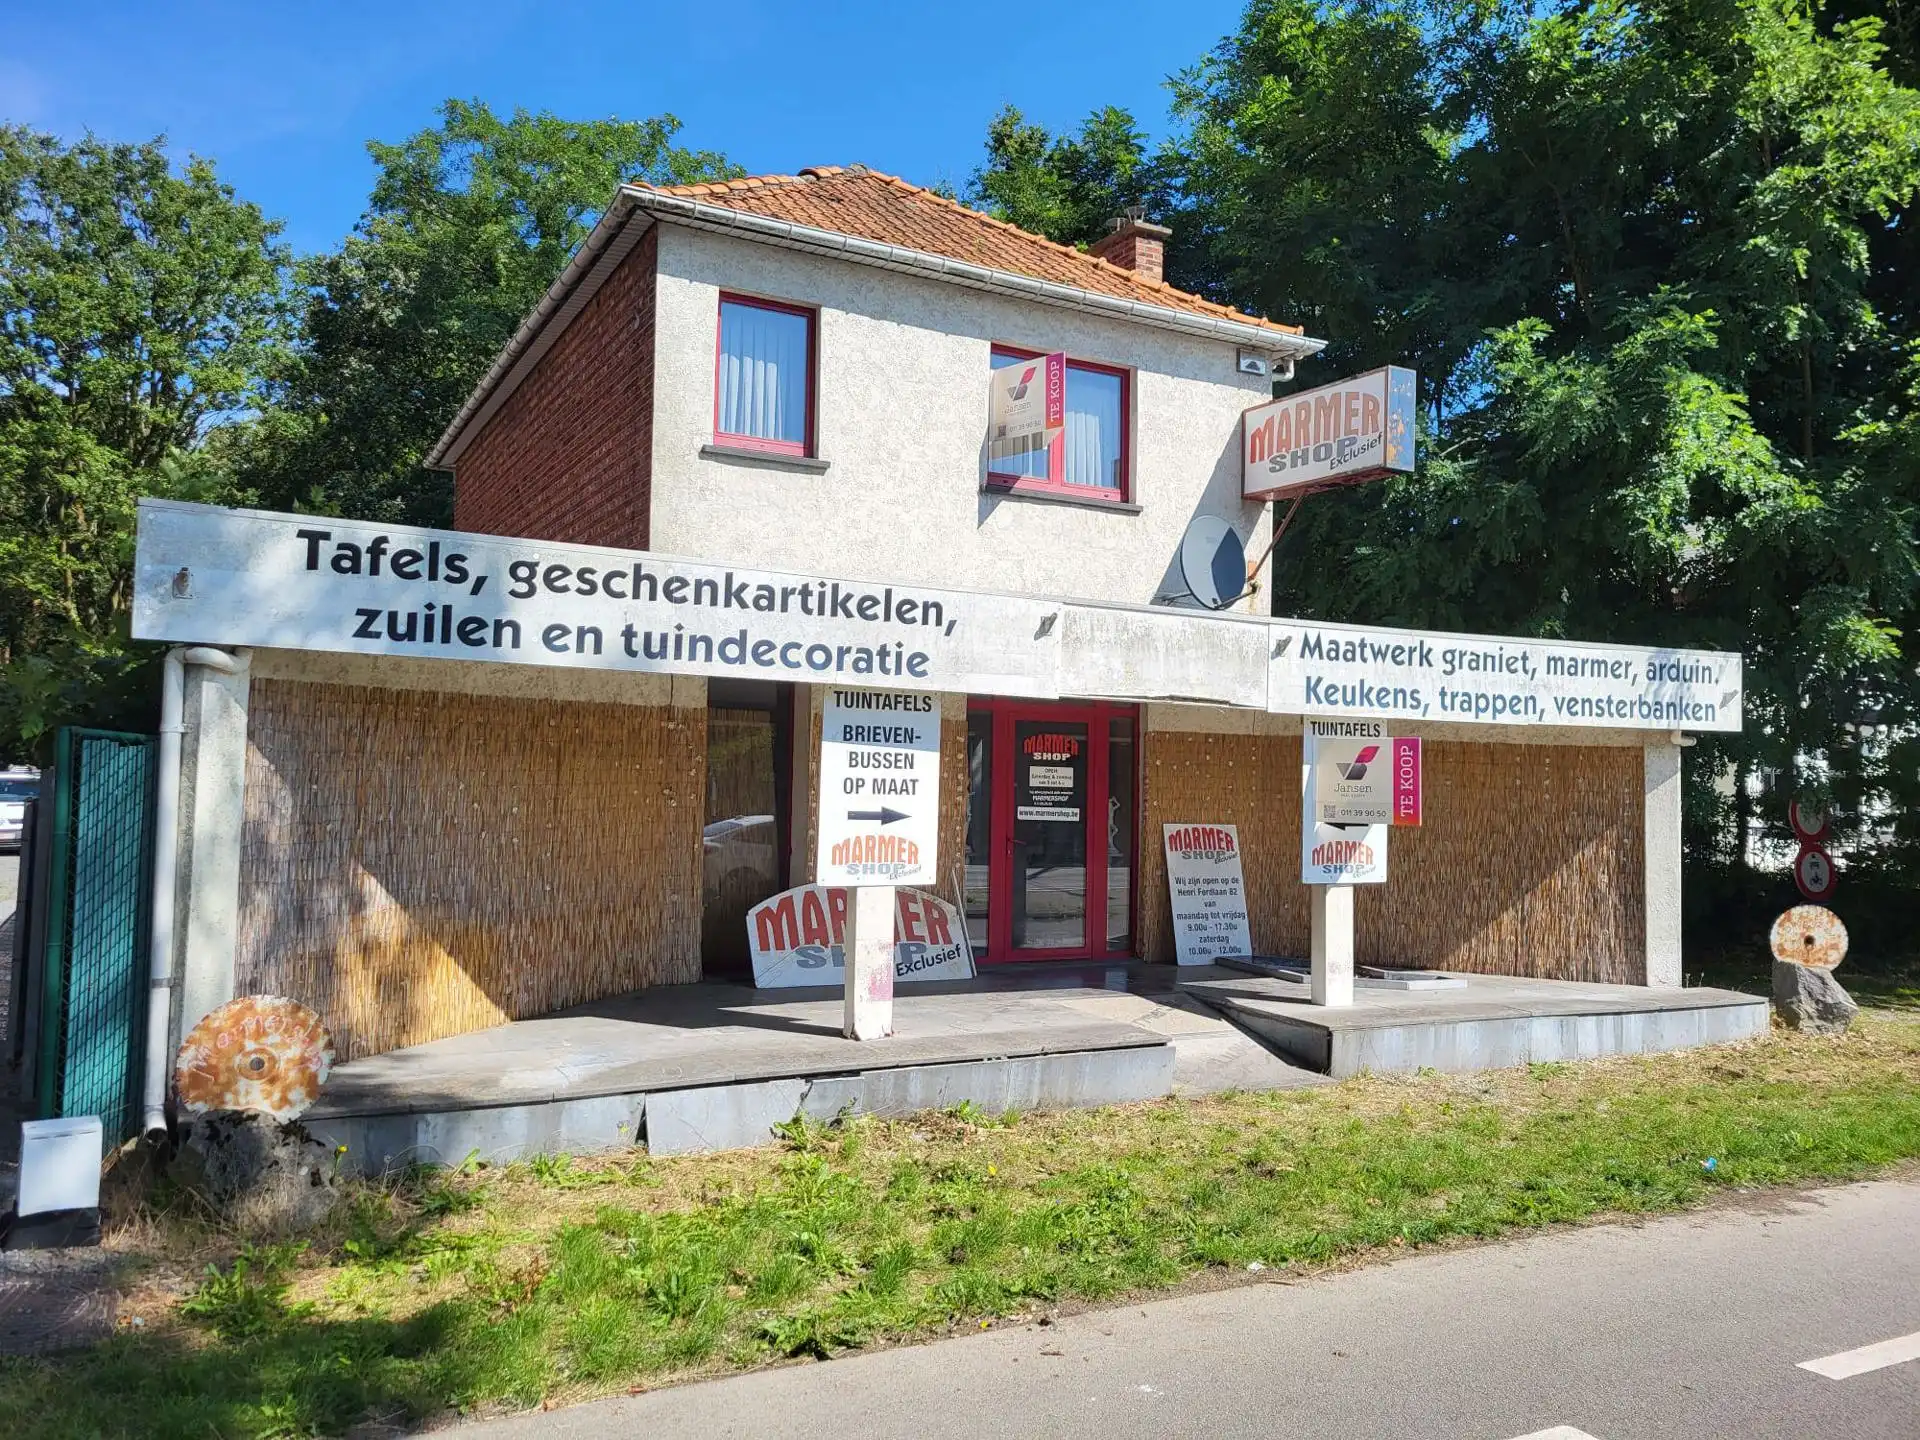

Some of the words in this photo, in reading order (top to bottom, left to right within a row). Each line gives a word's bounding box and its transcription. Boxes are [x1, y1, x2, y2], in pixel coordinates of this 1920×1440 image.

[1050, 361, 1060, 398] KOOP
[1050, 402, 1060, 422] TE
[1250, 391, 1381, 464] MARMER
[1268, 435, 1358, 474] SHOP
[1329, 431, 1383, 471] Exclusief
[296, 528, 489, 597] Tafels,
[508, 559, 958, 637] geschenkartikelen,
[352, 602, 522, 649] zuilen
[542, 622, 603, 656] en
[621, 622, 930, 679] tuindecoratie
[1299, 631, 1434, 668] Maatwerk
[1441, 645, 1537, 682] graniet,
[1546, 654, 1639, 688] marmer,
[833, 690, 932, 712] TUINTAFELS
[1305, 675, 1431, 718] Keukens,
[1439, 687, 1546, 724] trappen,
[1553, 696, 1717, 723] vensterbanken
[842, 724, 922, 745] BRIEVEN-
[1310, 720, 1381, 738] TUINTAFELS
[1023, 734, 1079, 756] MARMER
[848, 751, 915, 770] BUSSEN
[1032, 752, 1072, 761] SHOP
[1400, 745, 1414, 792] KOOP
[843, 777, 866, 795] OP
[872, 778, 919, 796] MAAT
[1334, 782, 1373, 793] Jansen
[1353, 809, 1363, 817] 39
[1364, 809, 1375, 817] 90
[1400, 797, 1414, 818] TE
[831, 834, 919, 866] MARMER
[1168, 827, 1235, 852] MARMER
[1181, 850, 1226, 860] SHOP
[1311, 840, 1374, 867] MARMER
[846, 863, 906, 875] SHOP
[1322, 864, 1365, 874] SHOP
[1174, 876, 1187, 887] Wij
[1187, 877, 1201, 887] zijn
[1202, 878, 1220, 886] open
[1220, 878, 1230, 887] op
[1231, 877, 1240, 885] de
[1177, 887, 1196, 897] Henri
[1204, 900, 1217, 908] van
[755, 888, 953, 951] MARER
[1176, 911, 1209, 921] maandag
[1210, 911, 1220, 920] tot
[1222, 910, 1246, 921] vrijdag
[1199, 935, 1230, 944] zaterdag
[796, 942, 927, 969] SP
[896, 944, 962, 977] Exclusief
